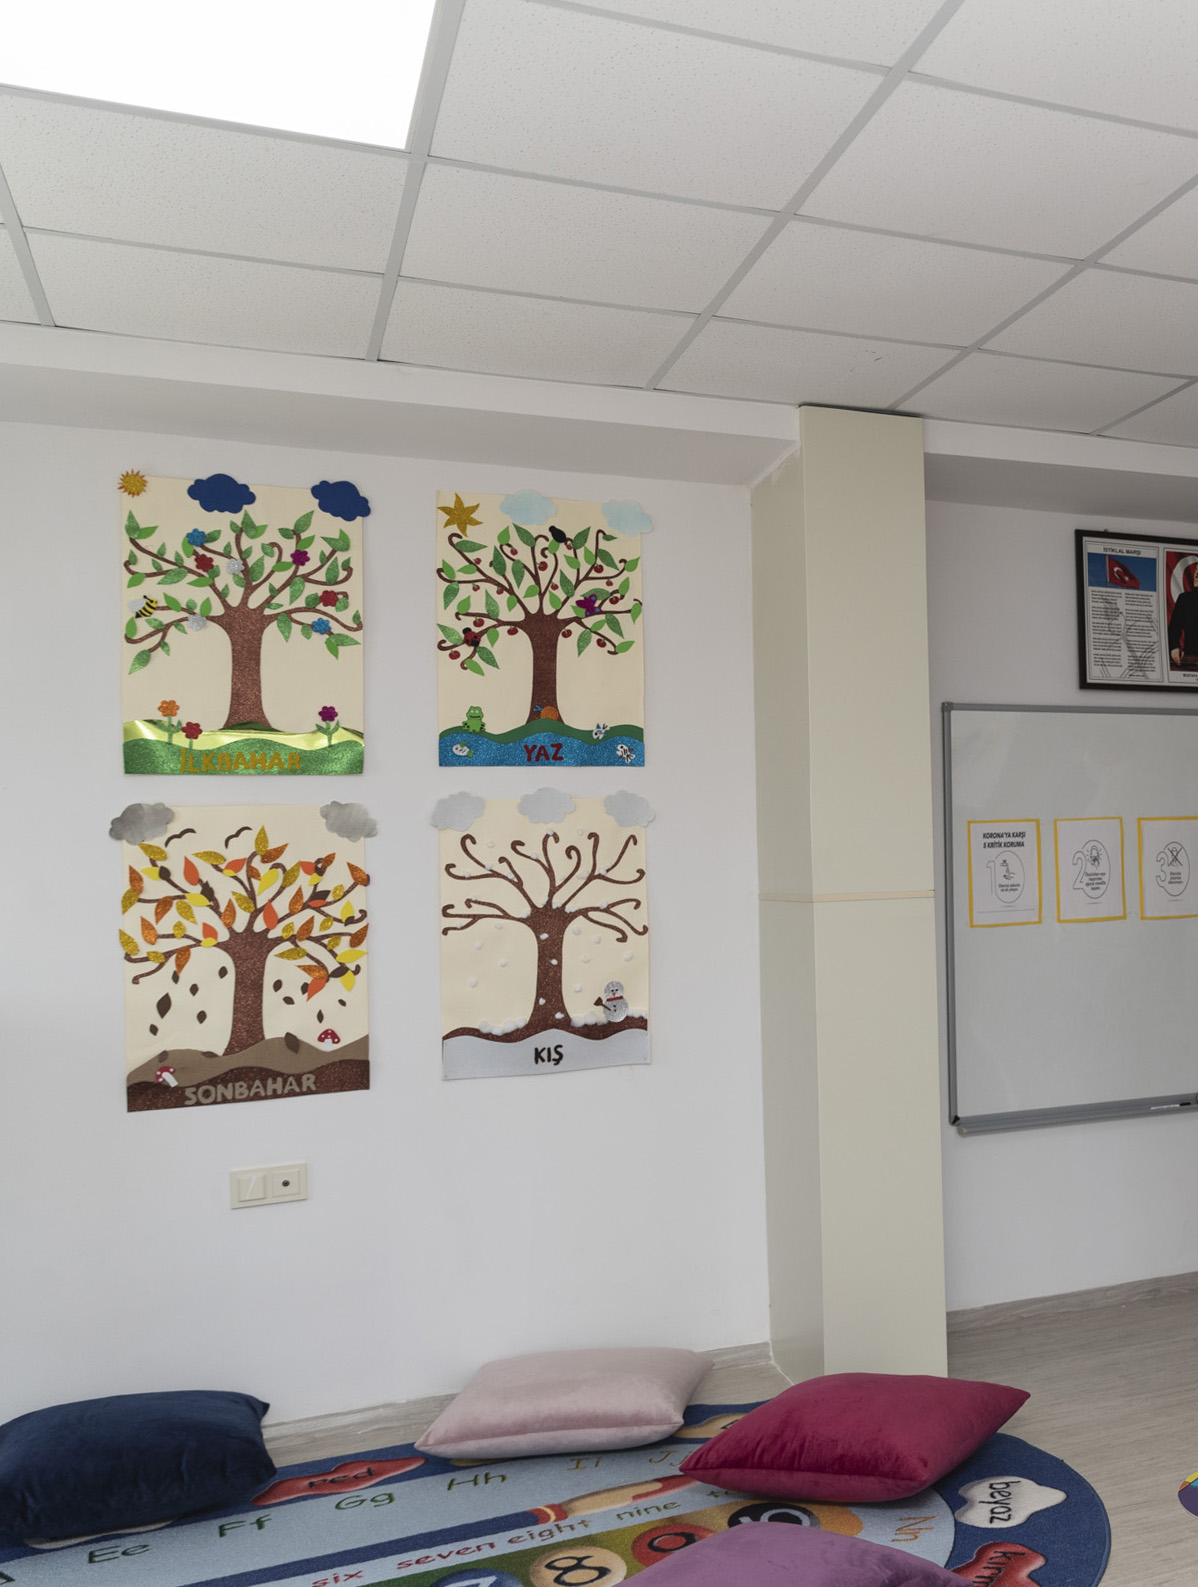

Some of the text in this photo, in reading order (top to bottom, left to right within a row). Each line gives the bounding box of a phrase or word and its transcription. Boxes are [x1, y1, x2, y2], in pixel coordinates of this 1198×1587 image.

[523, 742, 564, 762] YAZ
[1072, 850, 1087, 890] 2
[1156, 850, 1169, 888] 3
[534, 1044, 564, 1066] KIŞ
[184, 1073, 317, 1106] SONBAHAR
[308, 1467, 375, 1488] red
[88, 1544, 152, 1564] Ee
[218, 1514, 272, 1538] Ff
[334, 1492, 396, 1511] Gg
[447, 1472, 508, 1491] Hh
[979, 1480, 1021, 1524] beyaz
[312, 1501, 681, 1587] six seven eight nine
